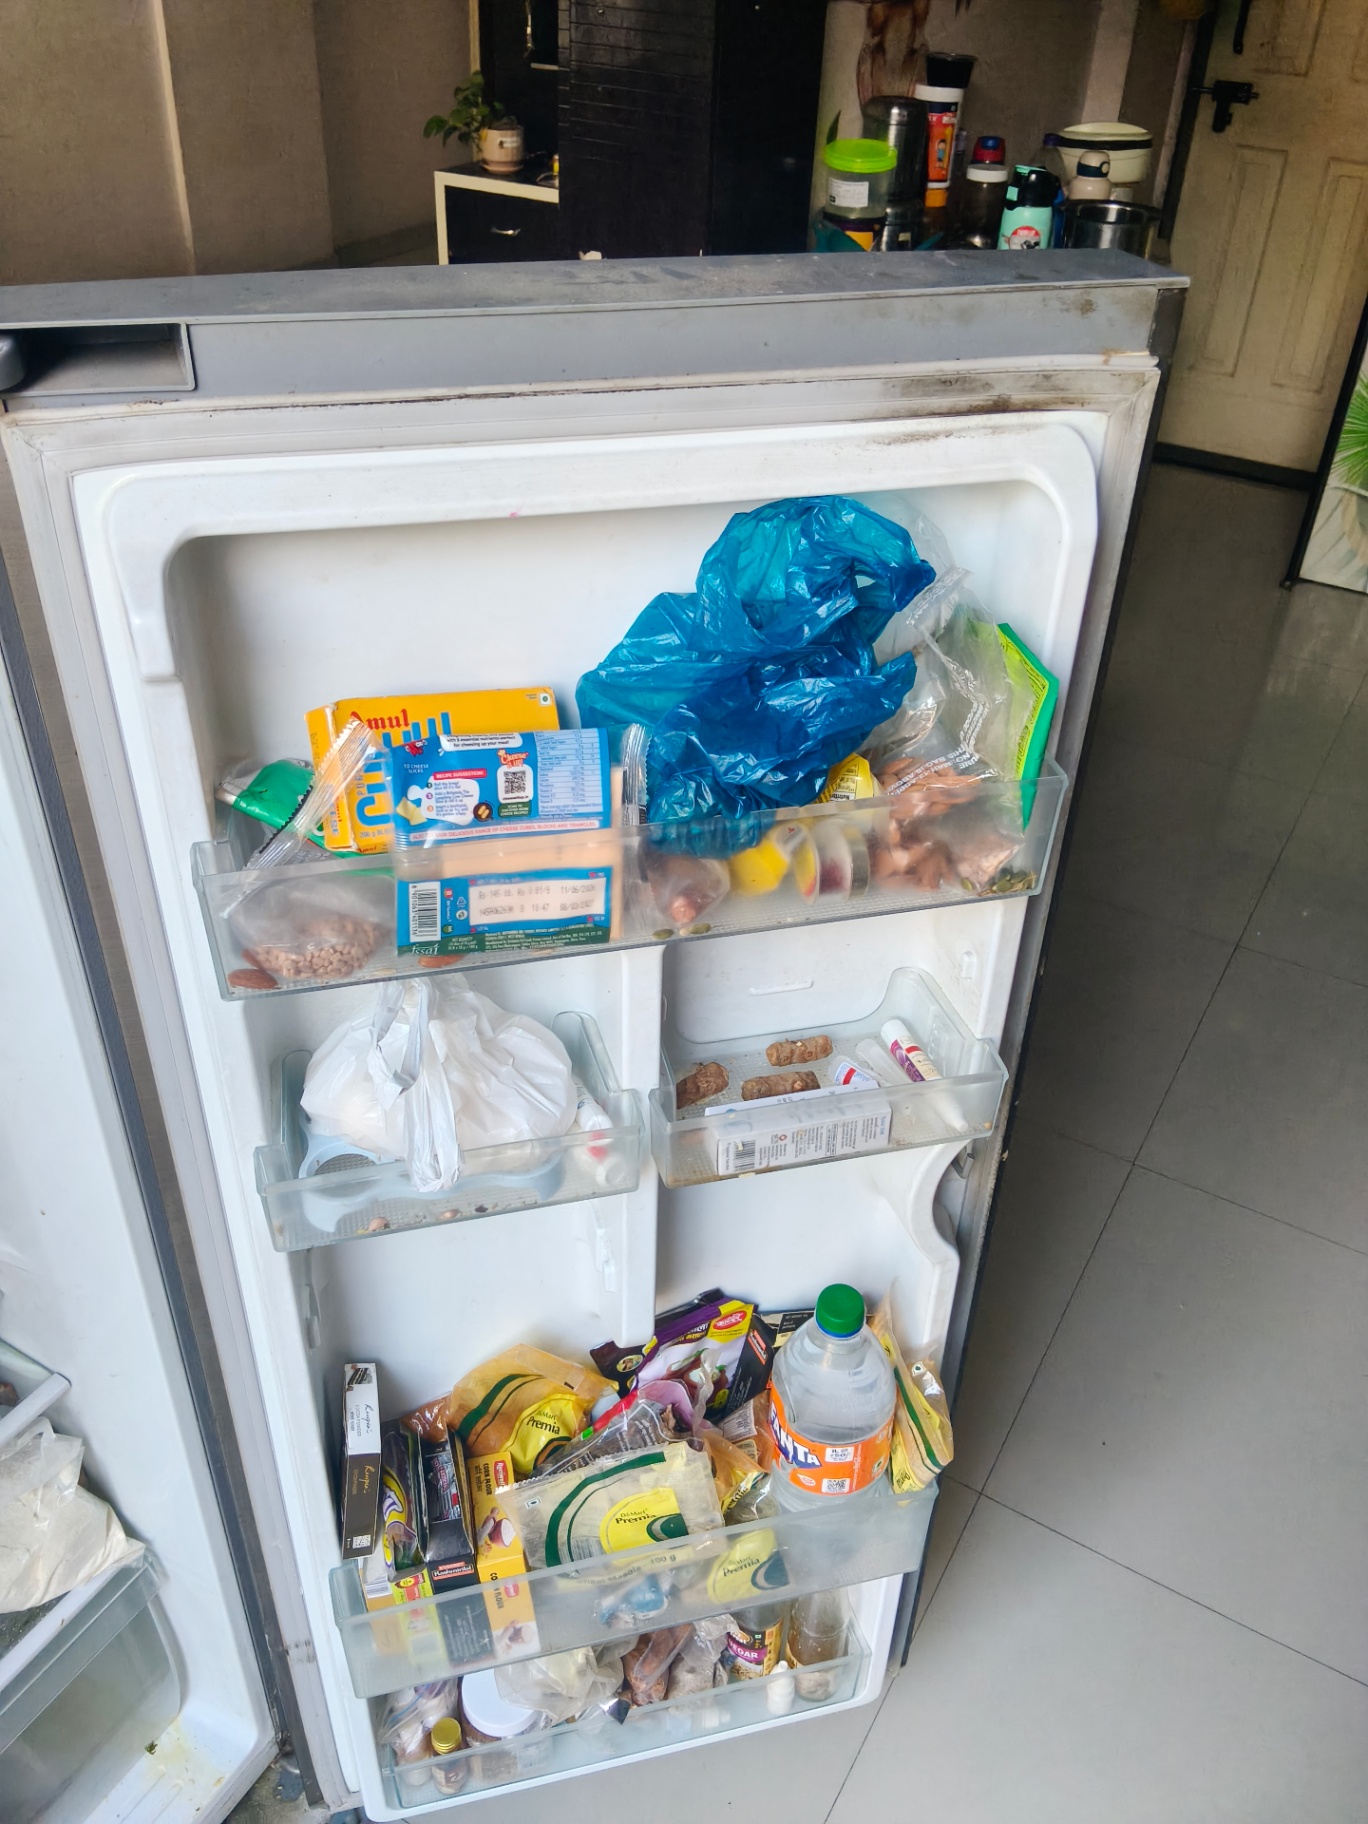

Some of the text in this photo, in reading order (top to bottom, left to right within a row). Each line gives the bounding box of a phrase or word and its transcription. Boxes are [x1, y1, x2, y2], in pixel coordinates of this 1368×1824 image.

[526, 1415, 561, 1435] Premia
[769, 1408, 821, 1466] FANTA
[615, 1513, 657, 1525] Premia
[723, 1558, 760, 1577] Premia
